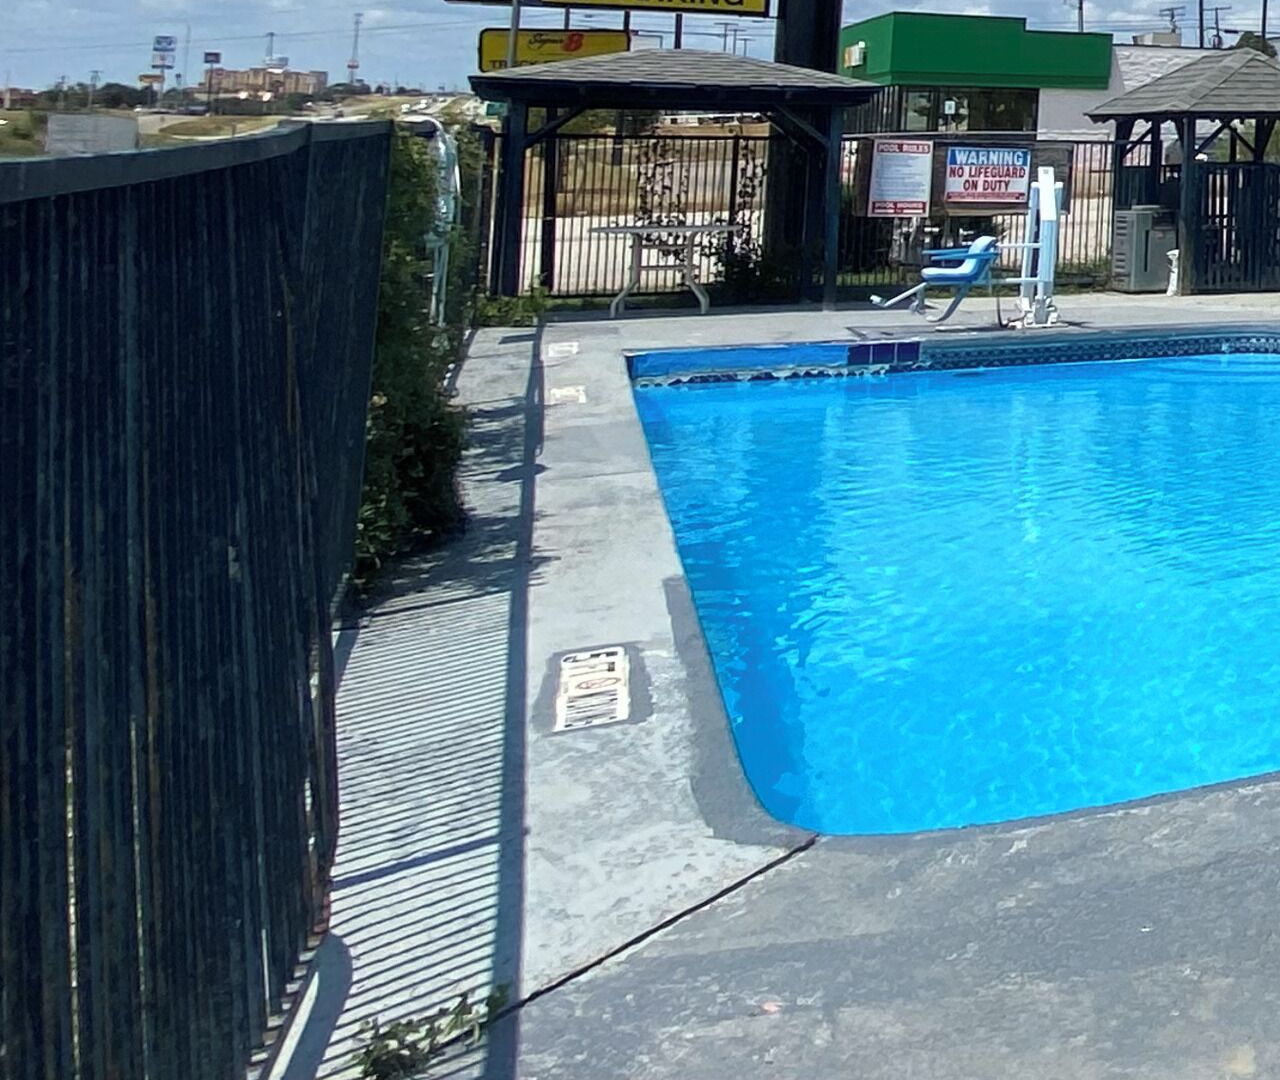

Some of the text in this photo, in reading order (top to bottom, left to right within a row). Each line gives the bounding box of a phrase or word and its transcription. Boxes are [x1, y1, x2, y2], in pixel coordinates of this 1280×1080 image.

[954, 150, 1024, 166] WARNING
[948, 166, 1026, 178] NO LIFEGUARD
[963, 180, 1011, 191] ON DUTY
